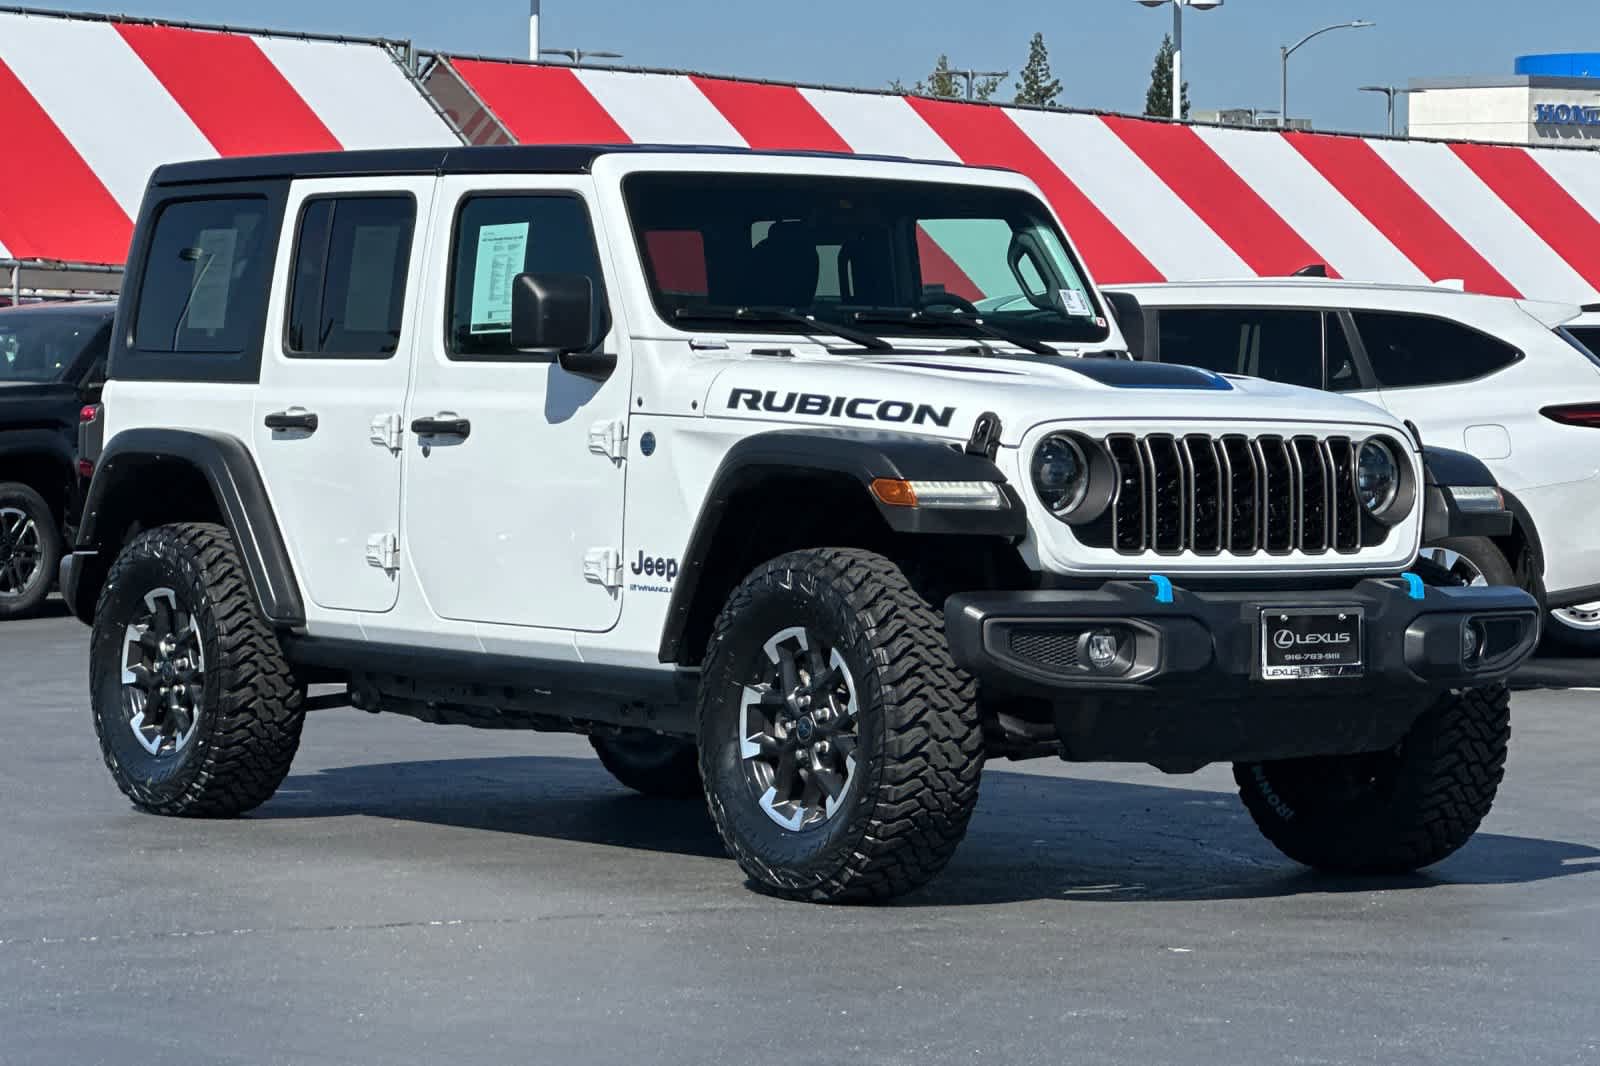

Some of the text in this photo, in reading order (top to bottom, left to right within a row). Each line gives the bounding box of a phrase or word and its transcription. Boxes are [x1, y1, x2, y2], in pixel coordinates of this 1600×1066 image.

[727, 388, 956, 427] RUBICON
[631, 550, 678, 582] Jeep
[1296, 633, 1351, 644] LEXUS
